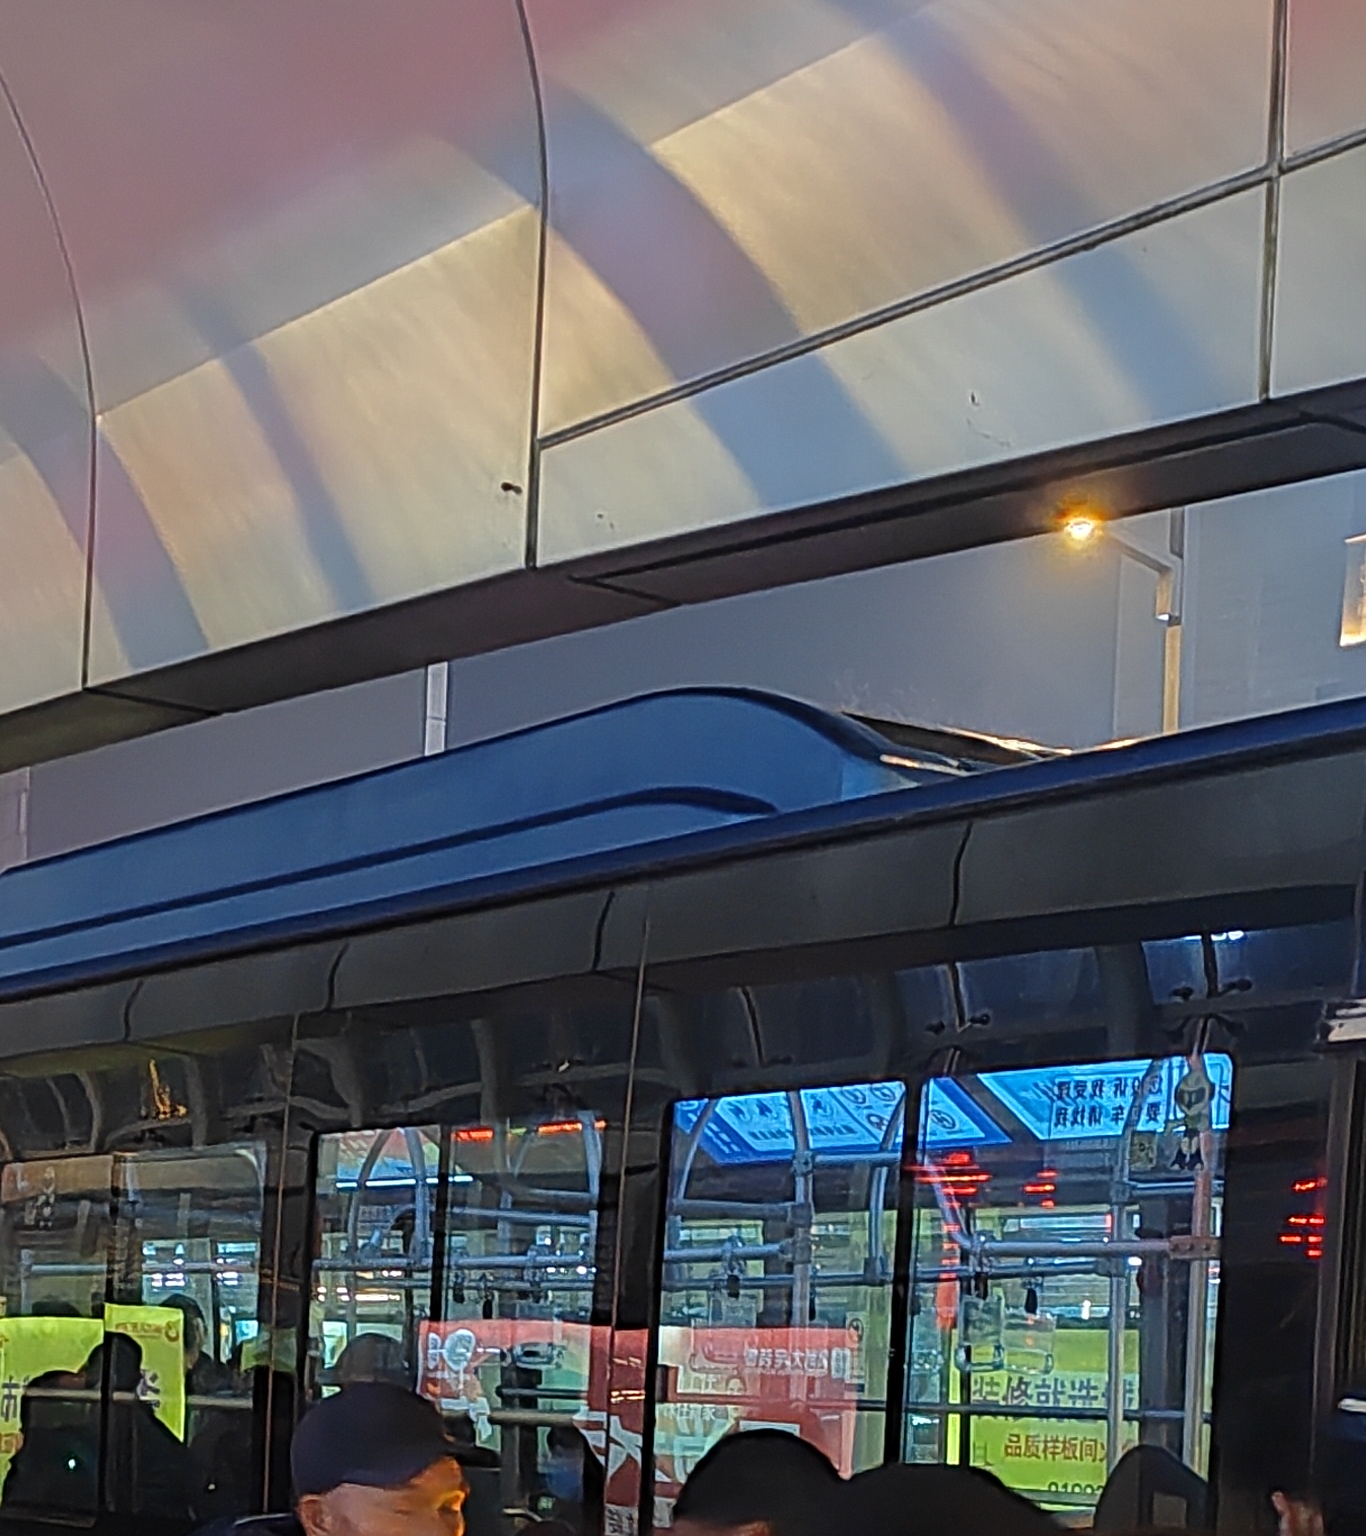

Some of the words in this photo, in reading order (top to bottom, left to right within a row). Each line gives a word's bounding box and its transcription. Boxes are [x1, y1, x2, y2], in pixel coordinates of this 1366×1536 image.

[1005, 1433, 1106, 1463] 品质样板间
